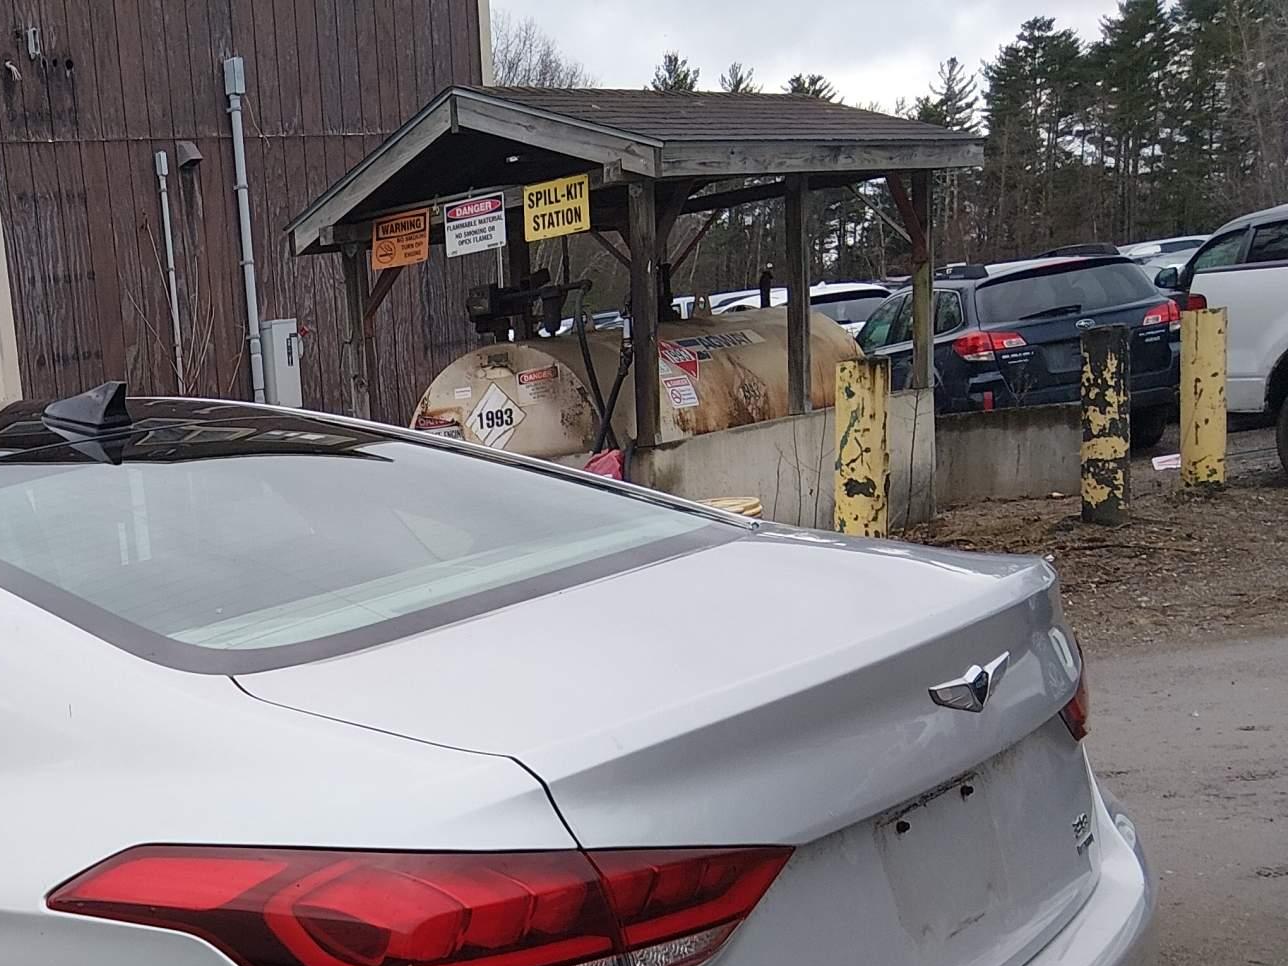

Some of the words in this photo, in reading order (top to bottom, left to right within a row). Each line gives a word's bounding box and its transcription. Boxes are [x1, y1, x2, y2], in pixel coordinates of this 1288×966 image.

[528, 181, 584, 209] SPILL-KIT
[455, 201, 492, 216] DANGER
[381, 218, 422, 236] WARNING
[447, 221, 477, 232] FLAMMABLE
[478, 214, 503, 225] MATERIAL
[533, 206, 582, 231] STATION
[464, 227, 487, 238] SMOKING
[477, 408, 514, 430] 1993
